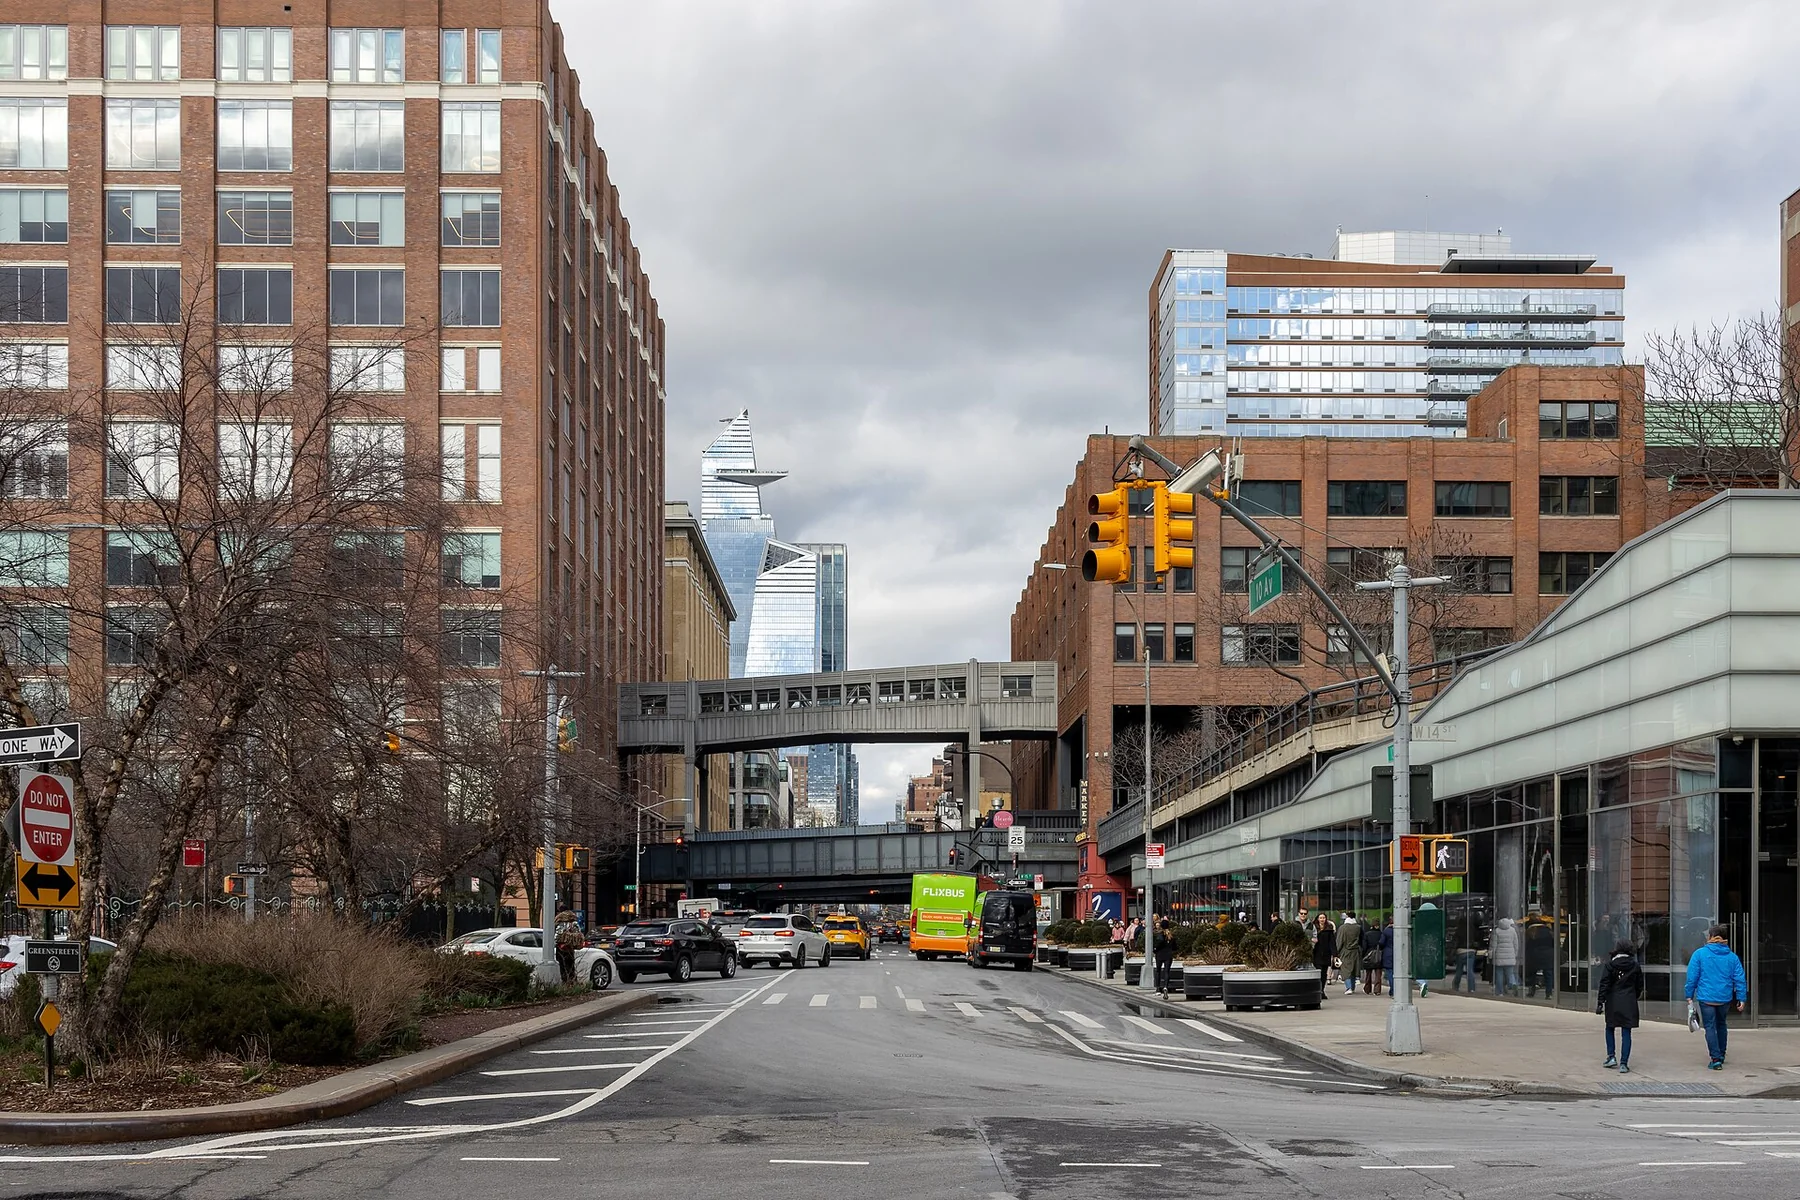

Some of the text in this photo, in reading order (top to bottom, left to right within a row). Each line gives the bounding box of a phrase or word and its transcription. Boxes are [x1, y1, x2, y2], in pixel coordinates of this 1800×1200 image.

[1255, 580, 1263, 602] 10
[1414, 725, 1424, 739] W
[1427, 725, 1439, 739] 14
[2, 735, 66, 753] ONE WAY
[30, 790, 64, 808] DO NOT
[1080, 780, 1088, 825] MARKET
[33, 830, 63, 846] ENTER
[1010, 836, 1023, 845] 25
[1402, 840, 1418, 851] DETOUR
[28, 947, 79, 955] GREENSTREETS
